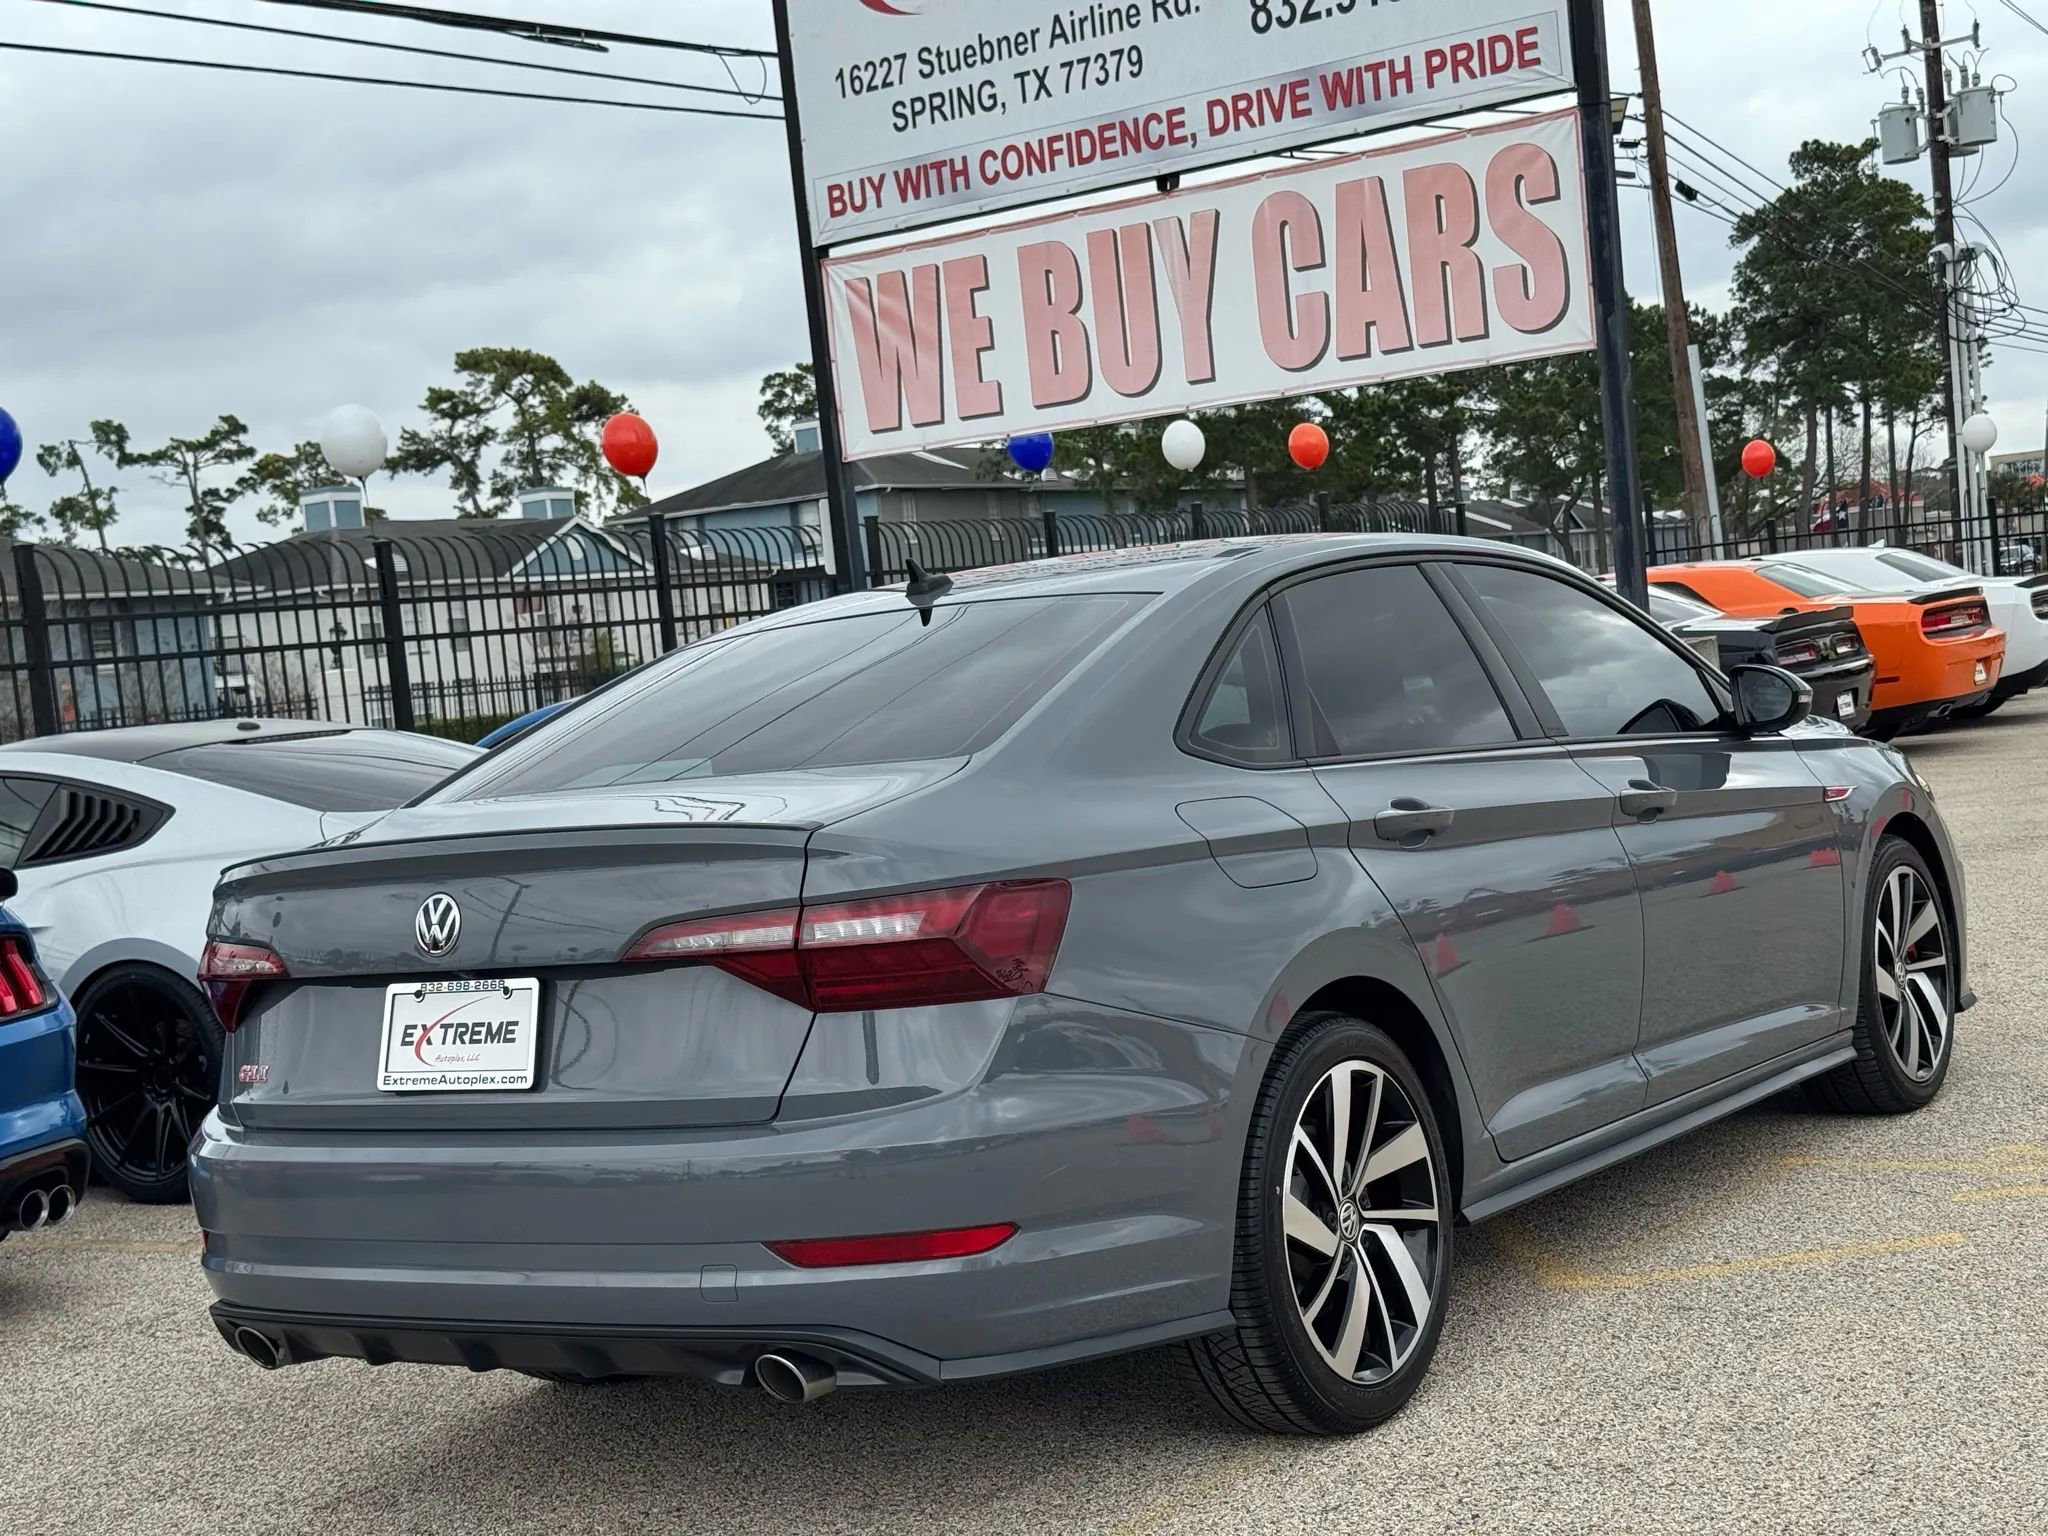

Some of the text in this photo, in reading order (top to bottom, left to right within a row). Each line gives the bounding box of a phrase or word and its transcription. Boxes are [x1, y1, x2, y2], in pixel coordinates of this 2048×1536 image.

[835, 53, 907, 99] 16227
[917, 27, 1041, 79] Stuebner
[1048, 3, 1142, 49] Airline
[892, 44, 1145, 132] SPRING, TX 77379
[827, 27, 1542, 218] BUY WITH CONFIDENCE, DRIVE WITH PRIDE
[845, 143, 1570, 433] WE BUY CARS
[400, 1020, 519, 1047] EXTREME
[382, 1073, 528, 1087] ExtremeAutoplex.com
